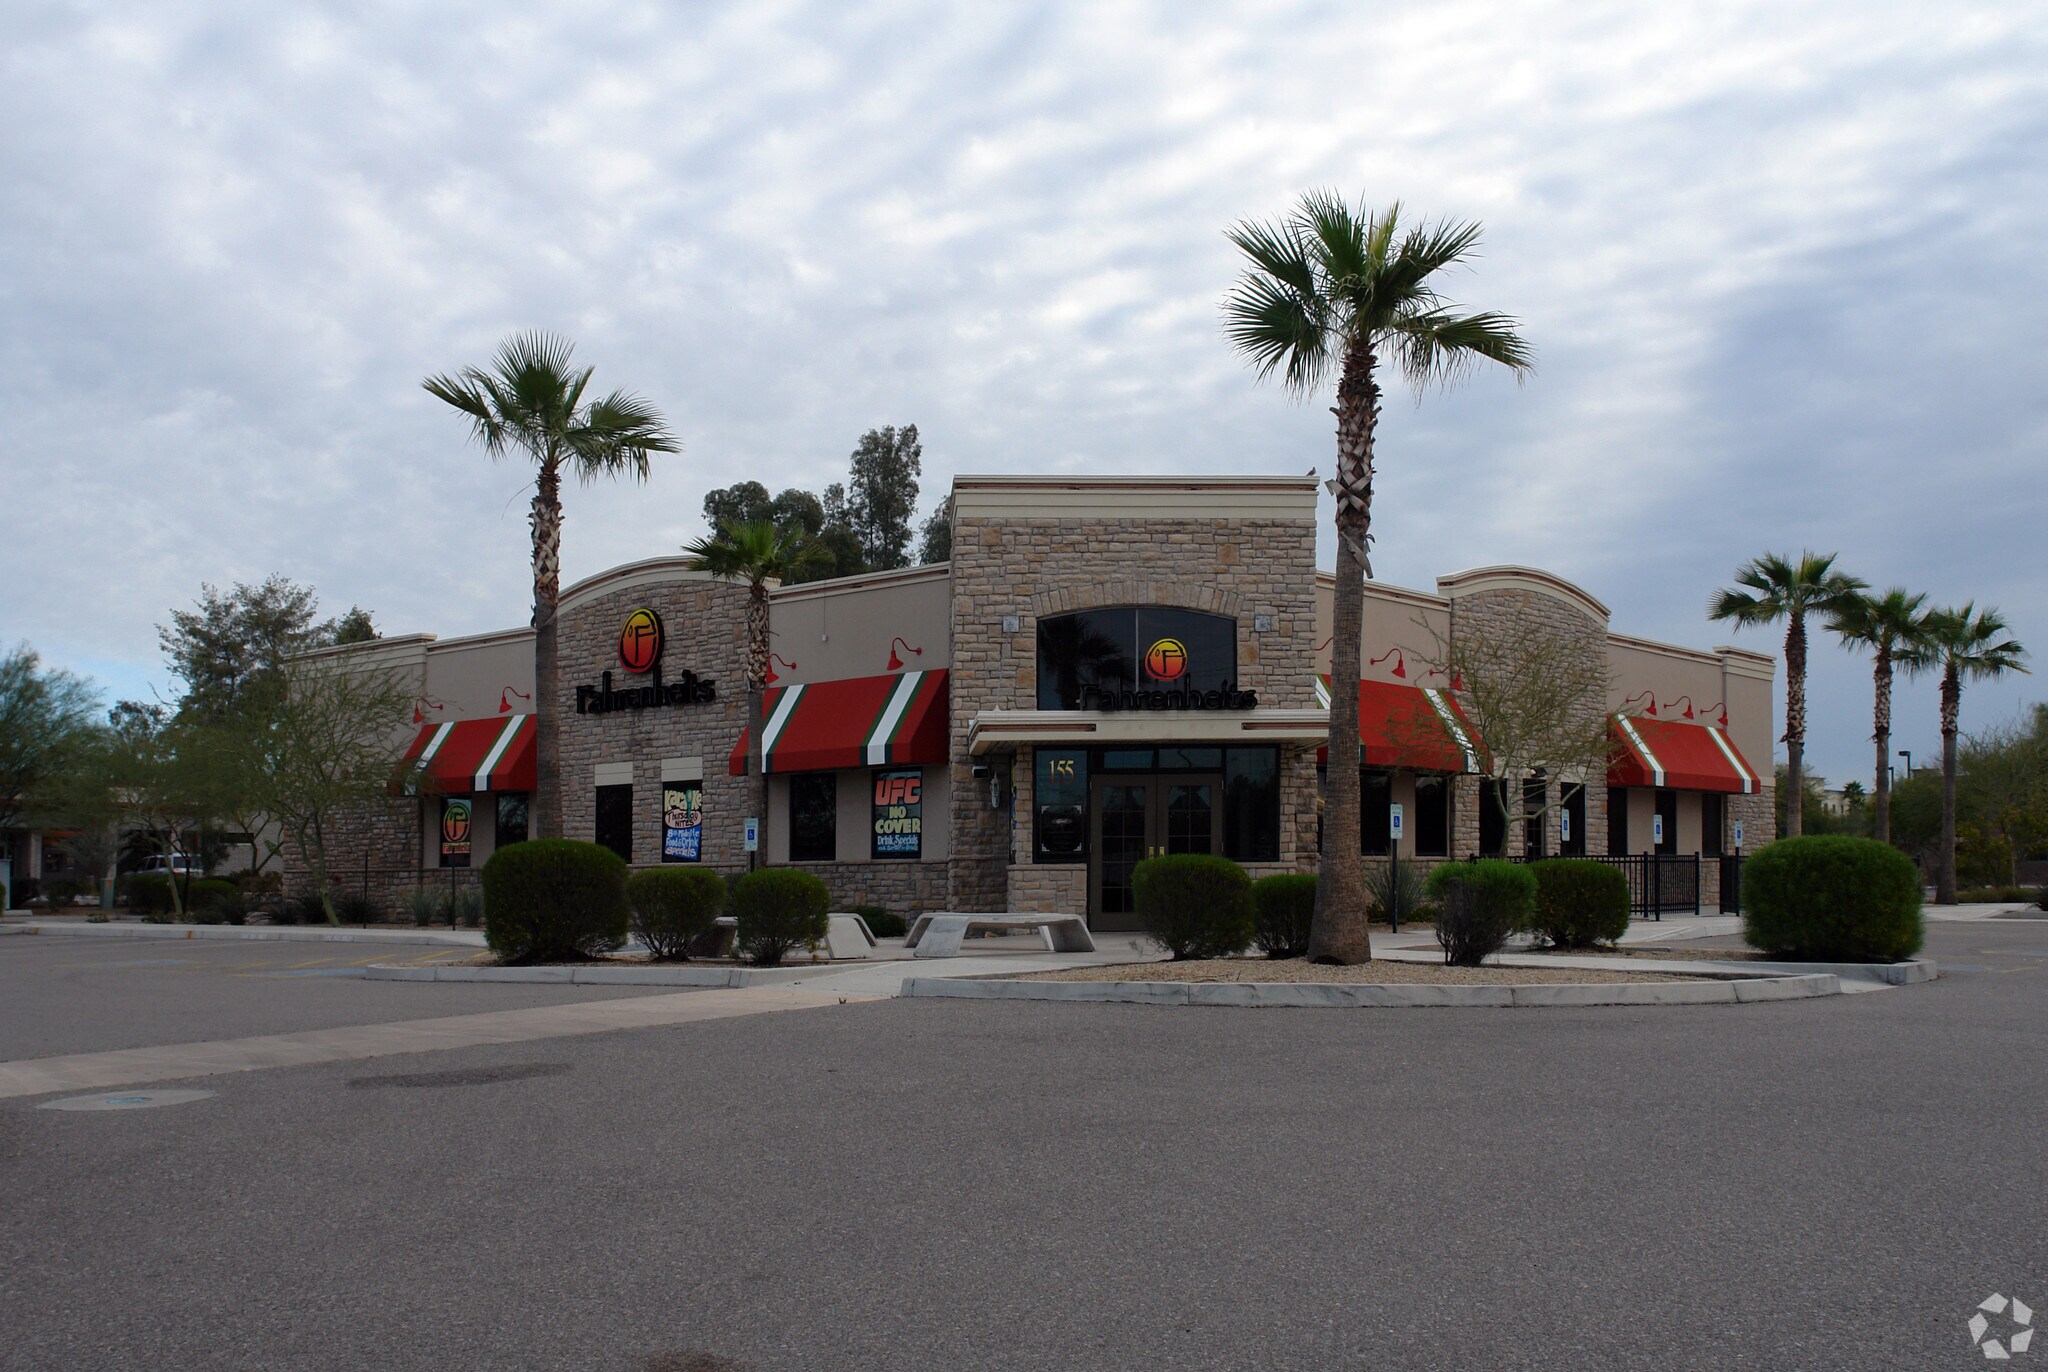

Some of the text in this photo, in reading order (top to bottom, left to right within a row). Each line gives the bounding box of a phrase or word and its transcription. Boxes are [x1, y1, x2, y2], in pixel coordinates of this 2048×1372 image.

[1082, 673, 1257, 711] Fahrenheits
[1049, 760, 1075, 785] 155
[875, 778, 921, 806] UFC
[888, 805, 907, 819] NO
[875, 818, 921, 833] COVER
